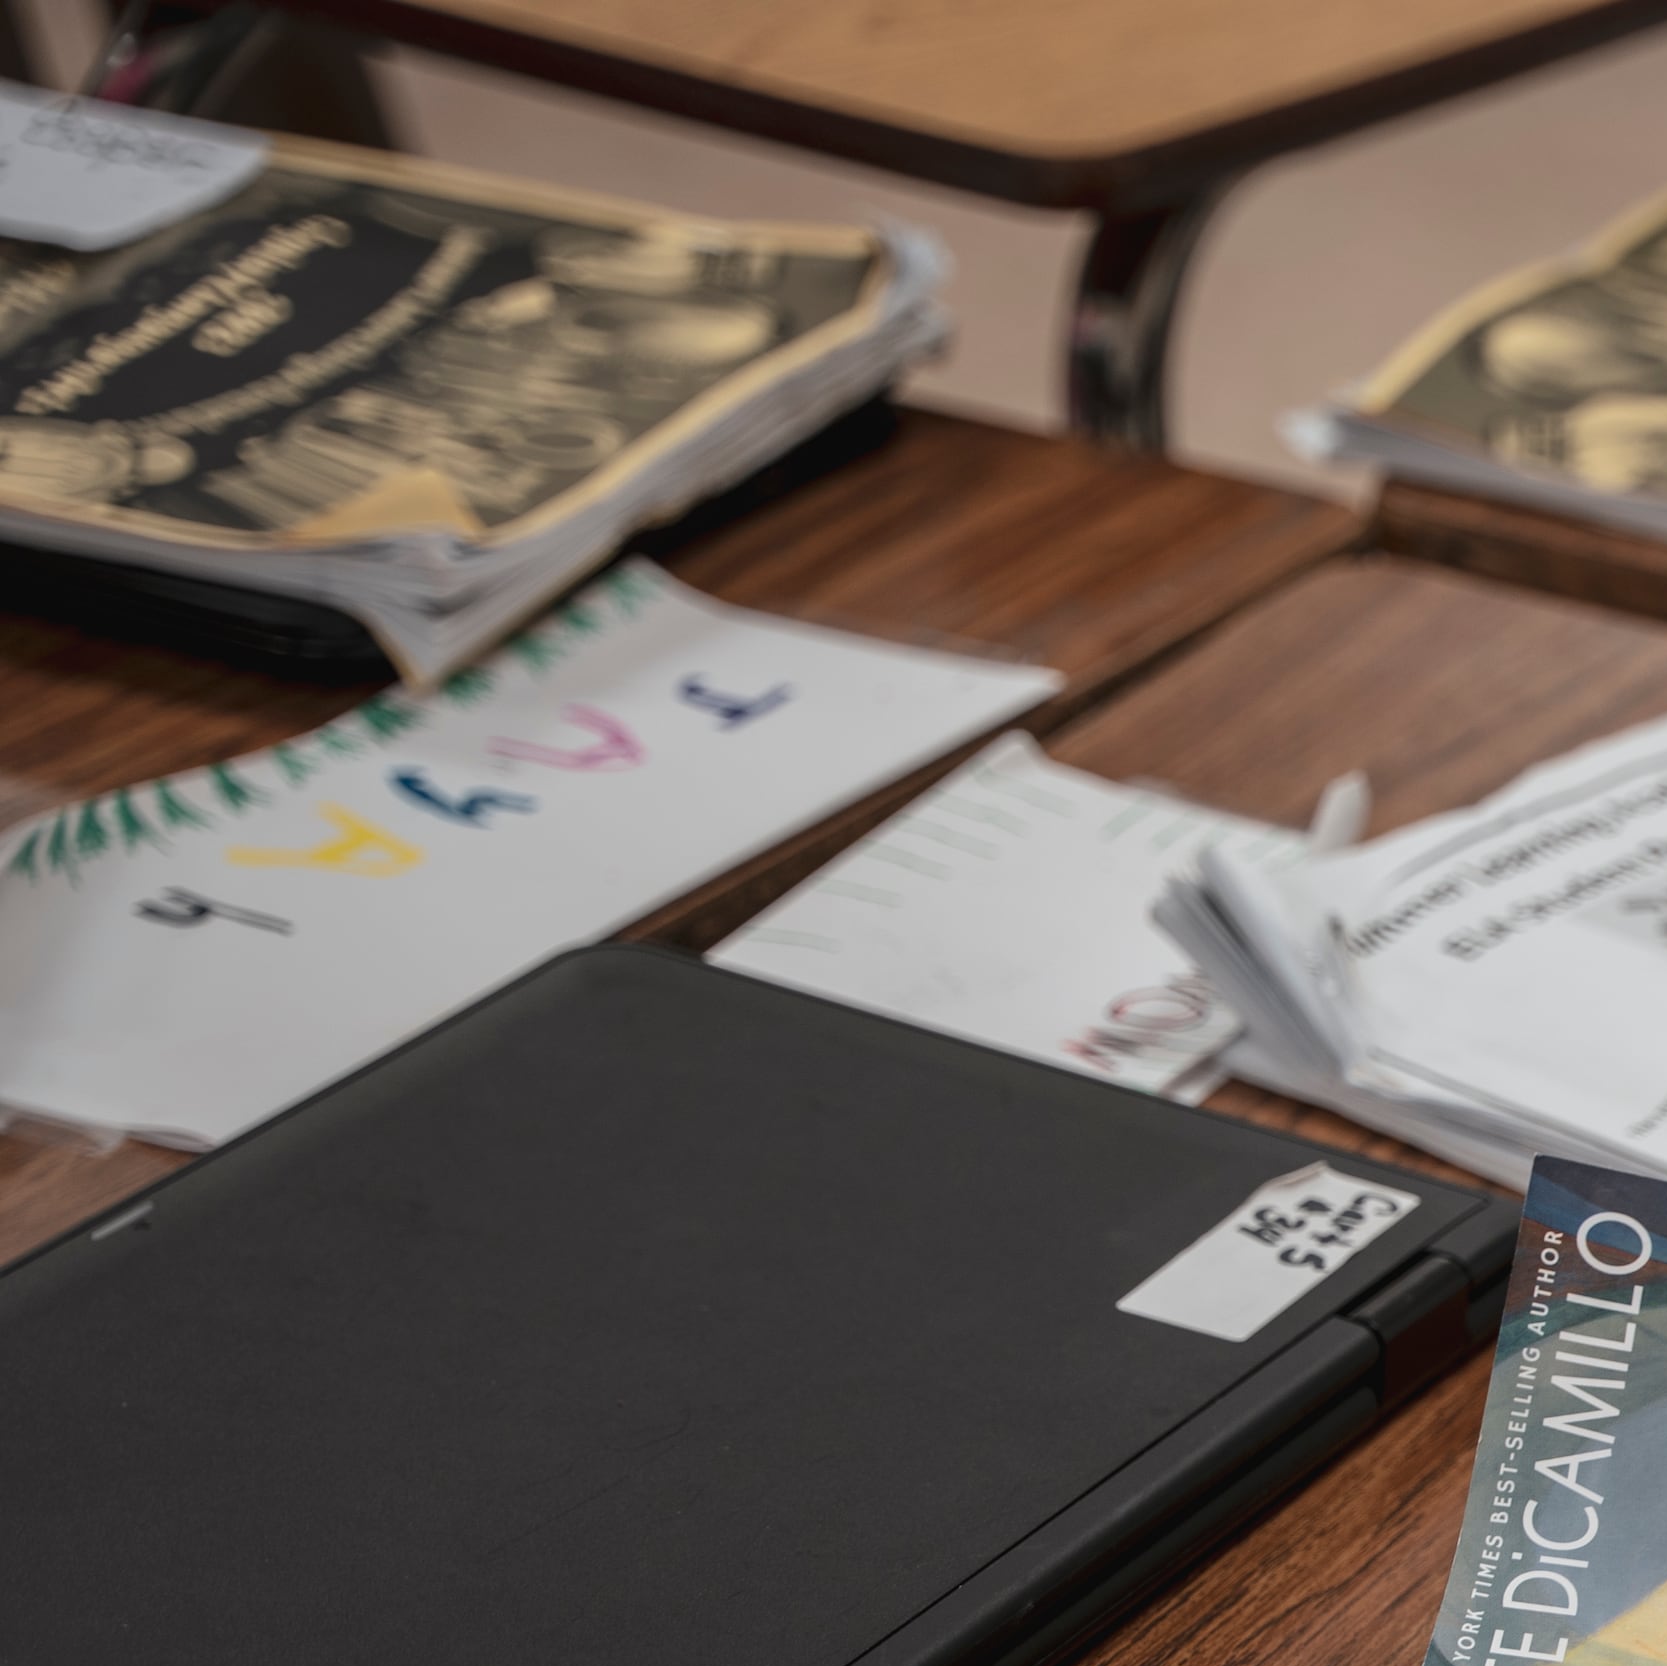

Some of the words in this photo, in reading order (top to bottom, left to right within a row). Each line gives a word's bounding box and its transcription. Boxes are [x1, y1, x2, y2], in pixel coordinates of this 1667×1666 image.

[1451, 1607, 1486, 1662] YORK
[1470, 1534, 1504, 1600] TIMES
[1489, 1346, 1541, 1524] BEST-SELLING
[1526, 1229, 1564, 1337] AUTHOR
[1501, 1210, 1653, 1617] DiCAMILLO
